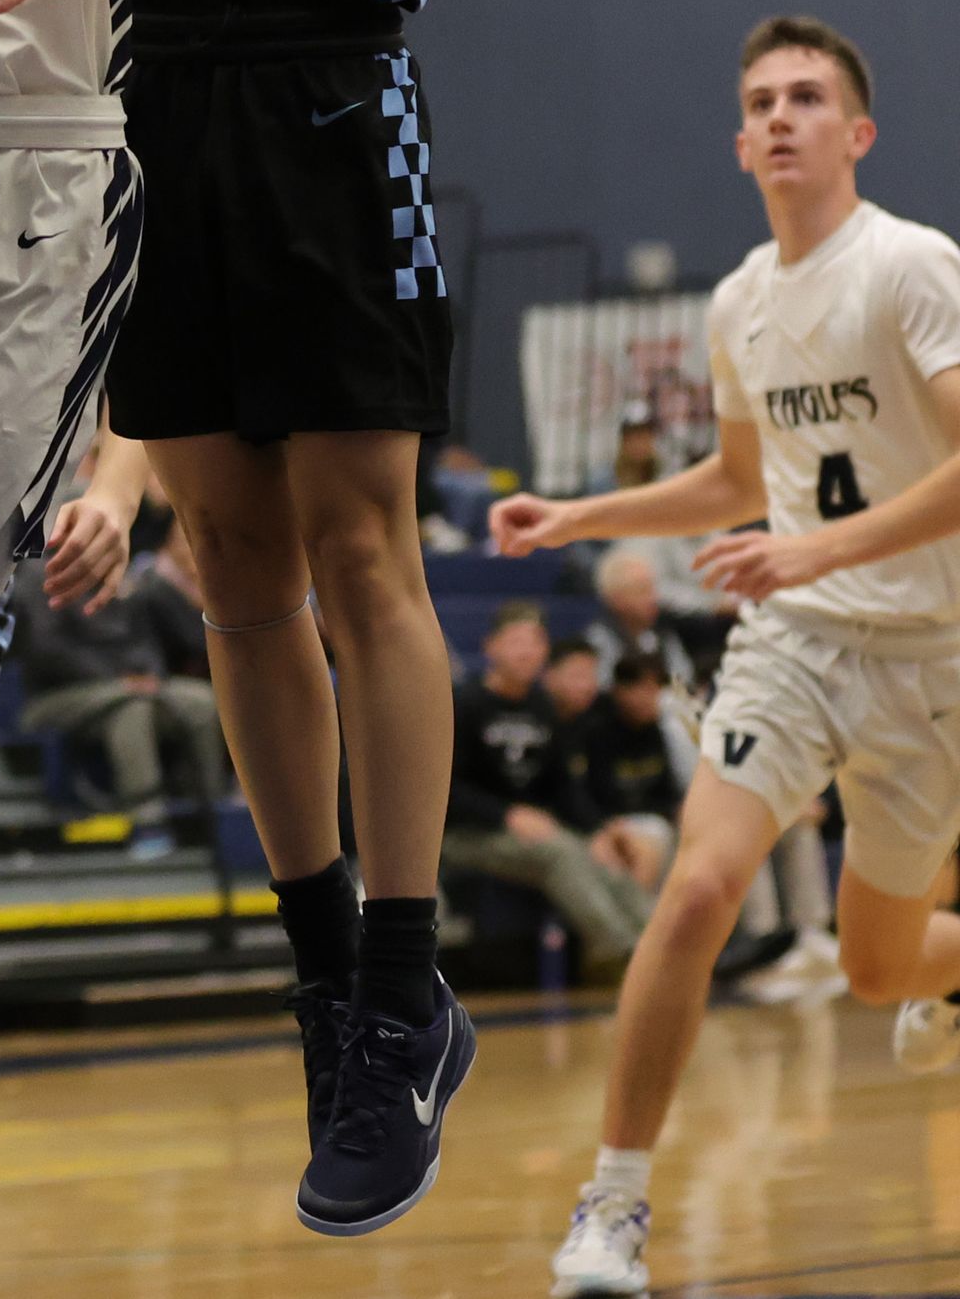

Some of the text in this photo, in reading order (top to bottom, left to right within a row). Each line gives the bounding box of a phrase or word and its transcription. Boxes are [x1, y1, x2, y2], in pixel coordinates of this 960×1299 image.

[765, 377, 879, 432] EAGLES
[817, 452, 870, 522] 4
[722, 729, 757, 767] V
